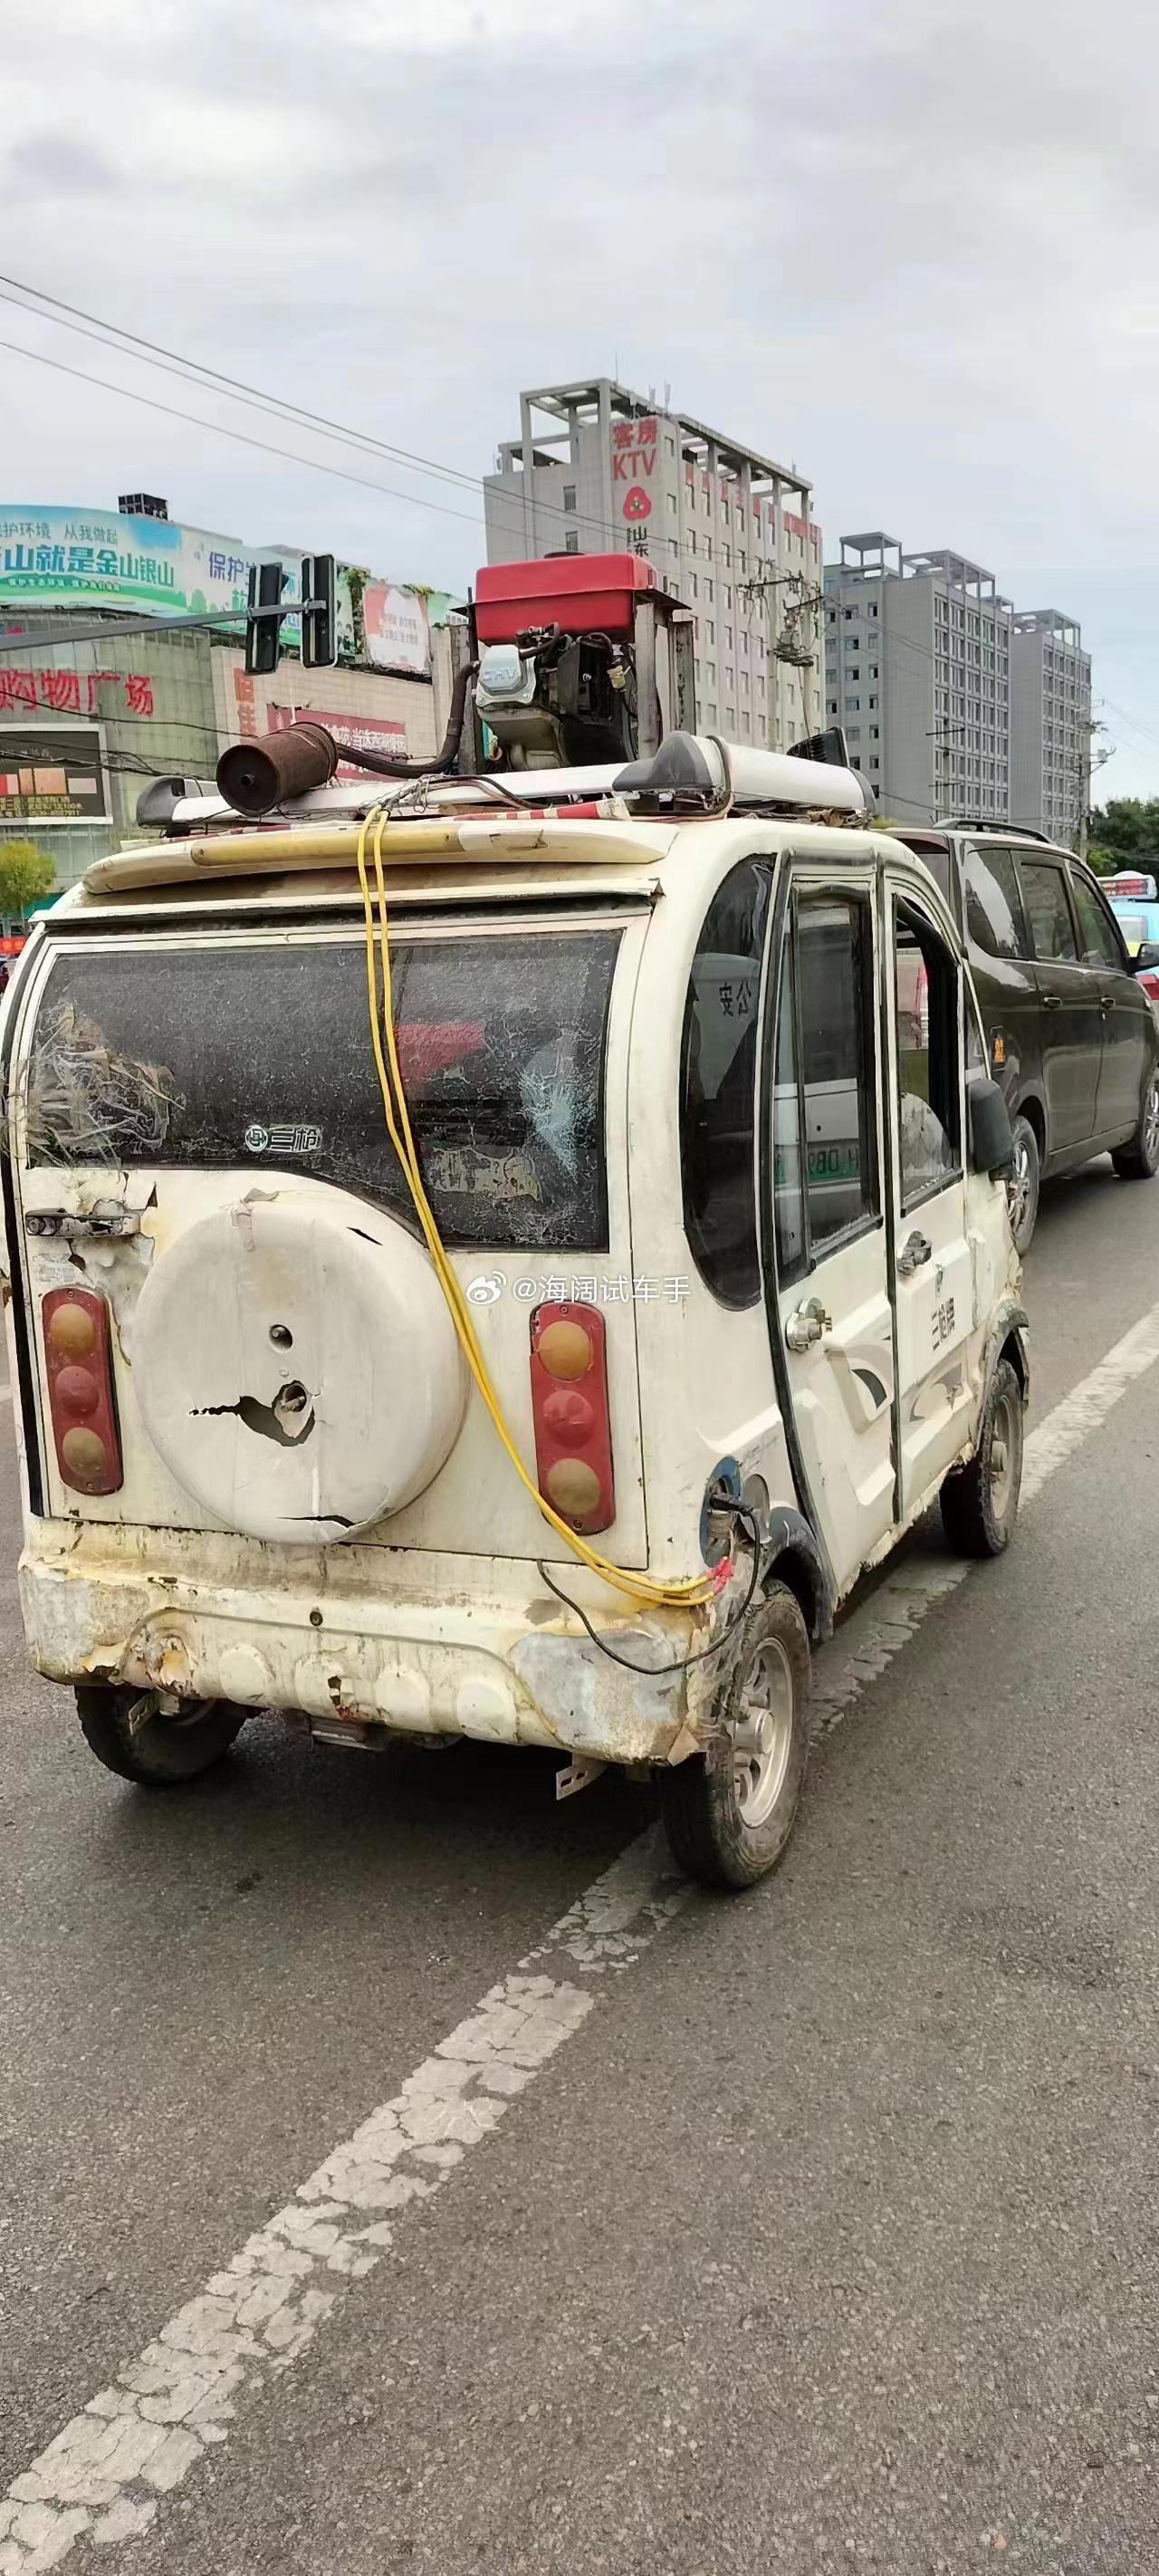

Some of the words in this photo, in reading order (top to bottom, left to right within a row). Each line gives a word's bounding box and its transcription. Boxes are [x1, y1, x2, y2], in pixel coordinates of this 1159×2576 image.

[613, 418, 658, 449] 客房
[612, 448, 656, 480] KTV
[0, 522, 52, 540] 护环境
[63, 524, 118, 545] 从我做起
[634, 525, 649, 558] 山东
[0, 543, 175, 588] 山就是金山银山
